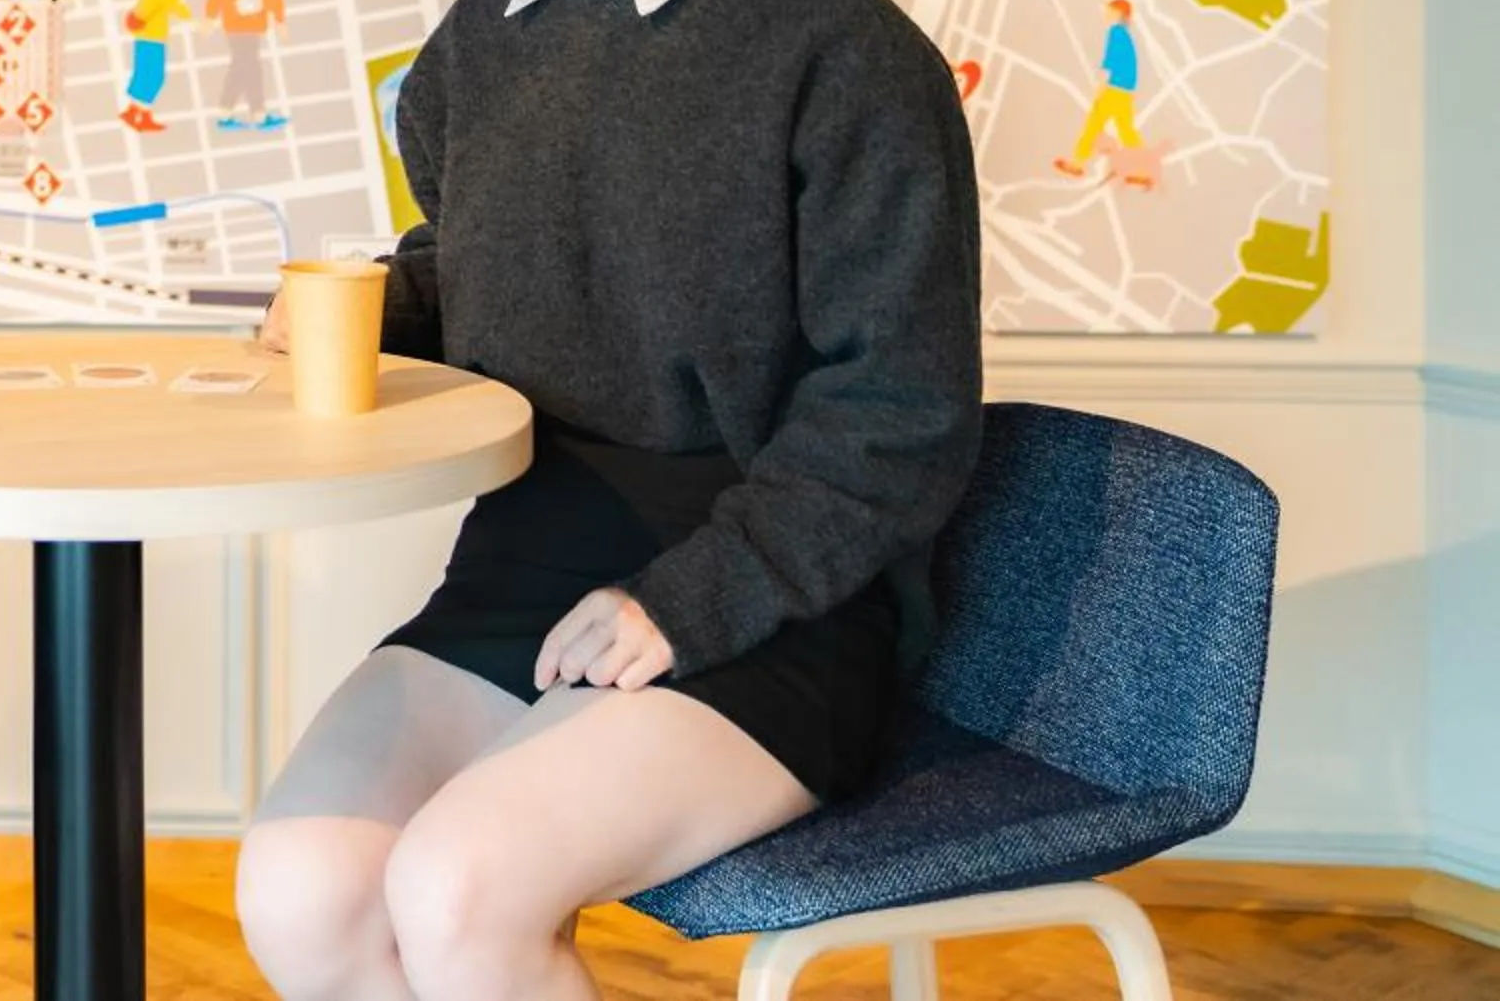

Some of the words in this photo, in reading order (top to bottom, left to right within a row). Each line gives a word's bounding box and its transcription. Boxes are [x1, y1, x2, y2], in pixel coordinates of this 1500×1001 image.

[7, 9, 29, 36] 2
[26, 99, 45, 125] 5
[33, 170, 51, 197] 8
